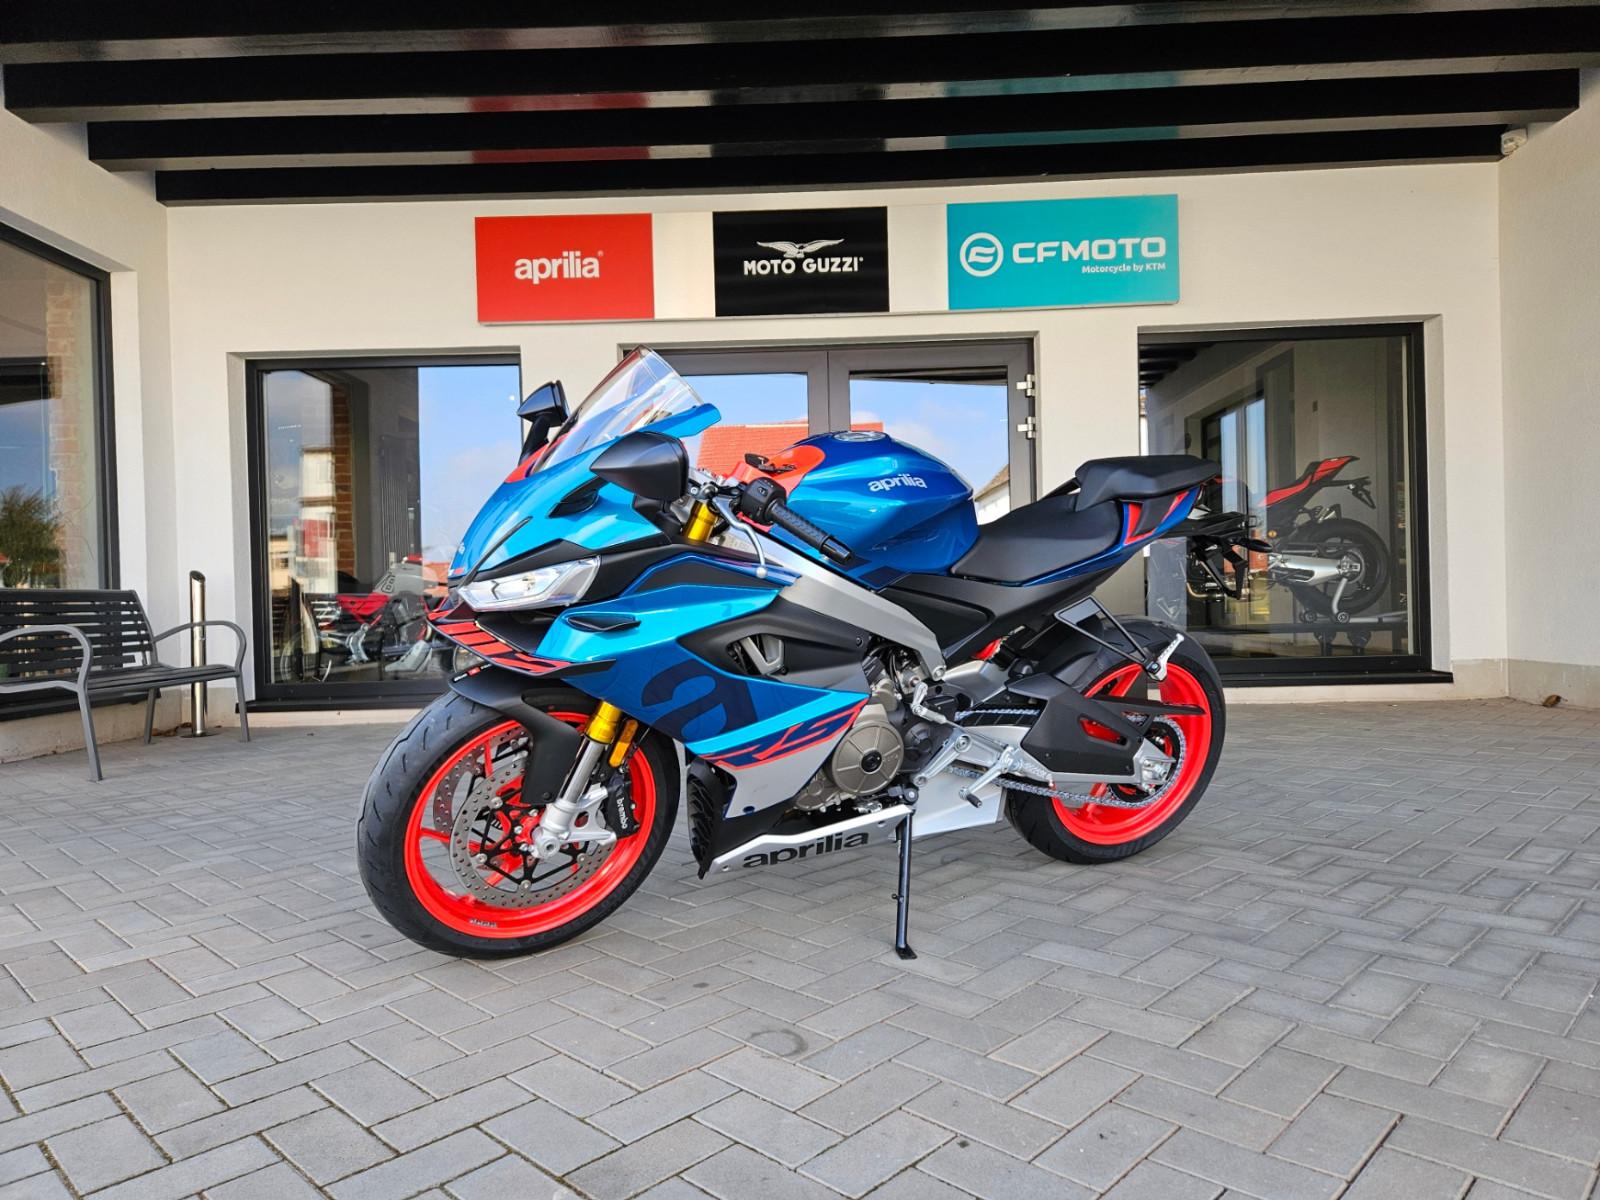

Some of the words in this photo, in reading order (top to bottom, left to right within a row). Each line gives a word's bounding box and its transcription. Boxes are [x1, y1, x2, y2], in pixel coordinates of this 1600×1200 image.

[1012, 237, 1167, 263] CFMOTO
[514, 250, 600, 285] aprilia
[743, 258, 796, 276] MOTO
[802, 256, 859, 273] GUZZI
[1082, 264, 1131, 274] Motorcycle
[1133, 263, 1144, 273] by
[1145, 262, 1167, 272] KTM
[868, 473, 928, 492] aprilia
[742, 832, 869, 868] aprilia
